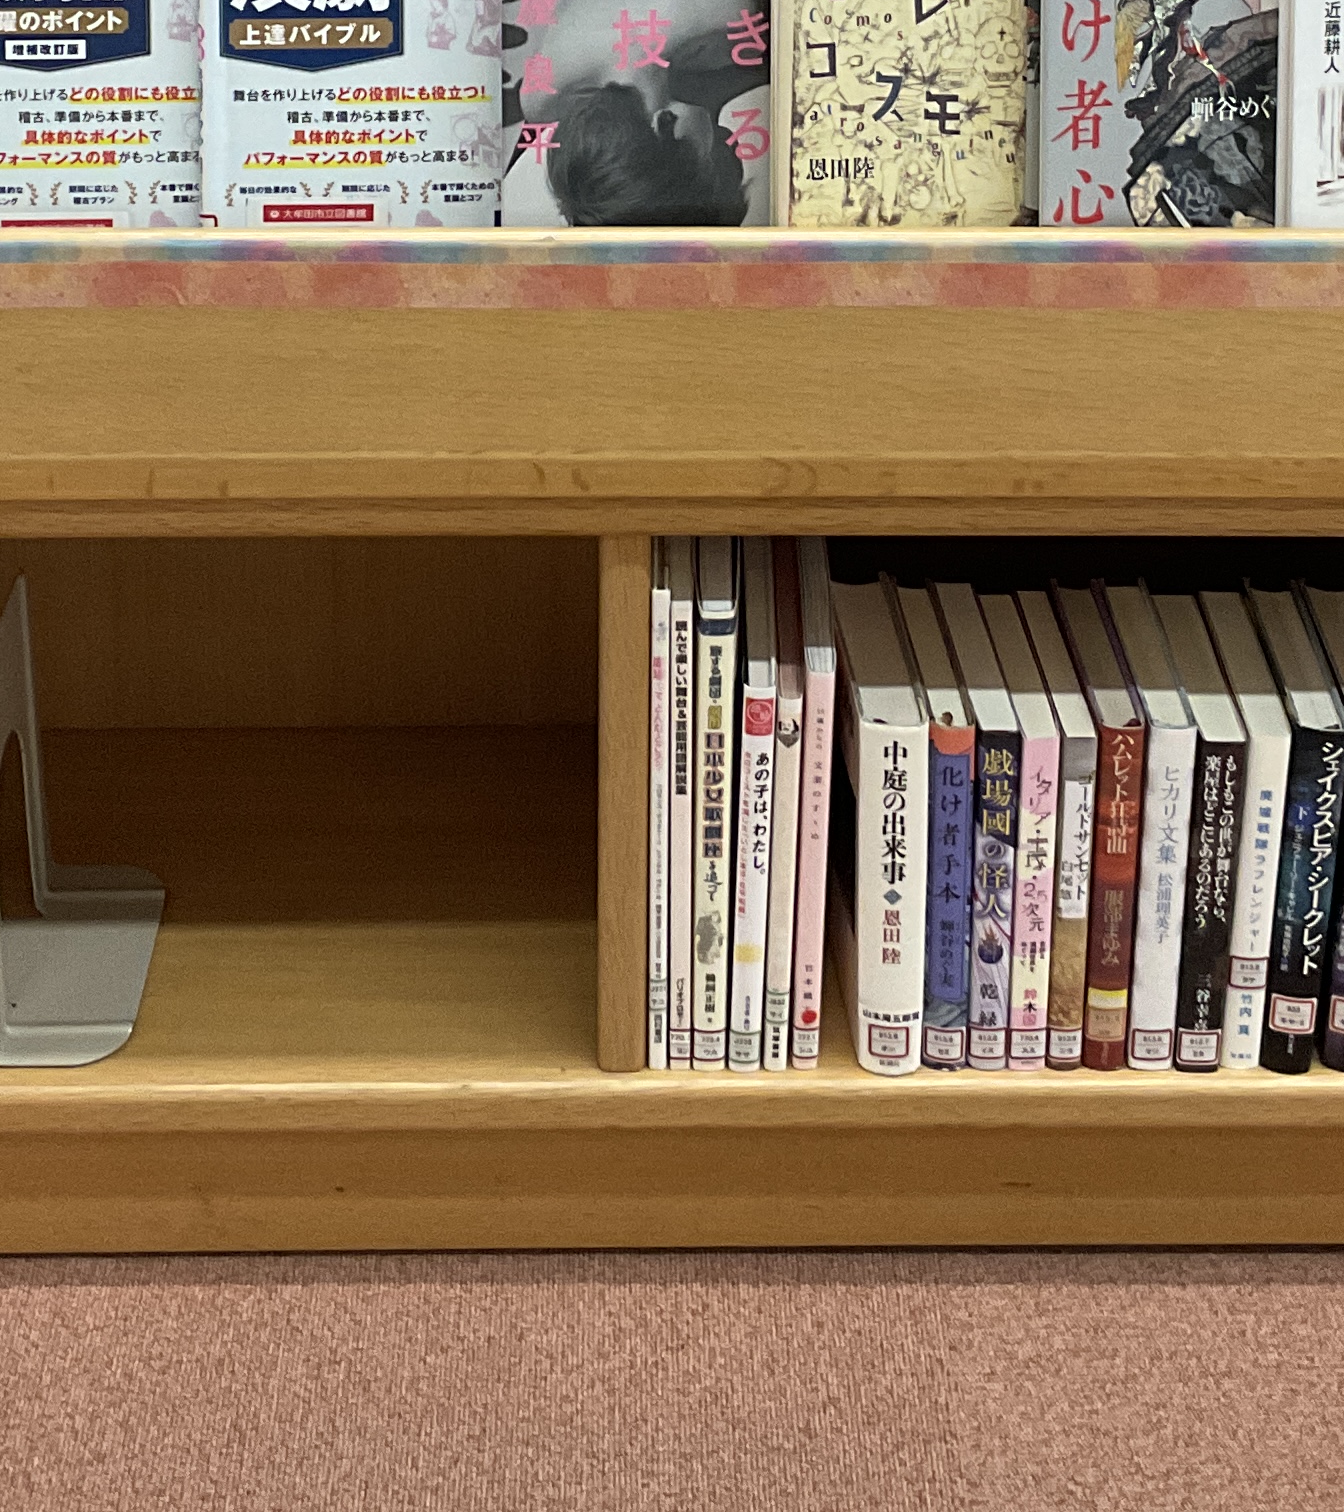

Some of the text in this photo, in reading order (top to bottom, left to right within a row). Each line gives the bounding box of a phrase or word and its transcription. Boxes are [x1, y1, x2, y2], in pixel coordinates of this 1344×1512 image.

[239, 23, 381, 46] 上達バイブル
[23, 129, 163, 145] 具体的なポイントで
[291, 129, 428, 145] 具体的なポイントで
[881, 740, 908, 886] 中庭の出来事
[1106, 732, 1136, 856] ハムレット狂詩曲
[1157, 765, 1181, 865] ヒカリ文集
[939, 765, 964, 903] 化け者手本
[881, 909, 902, 966] 恩田陸
